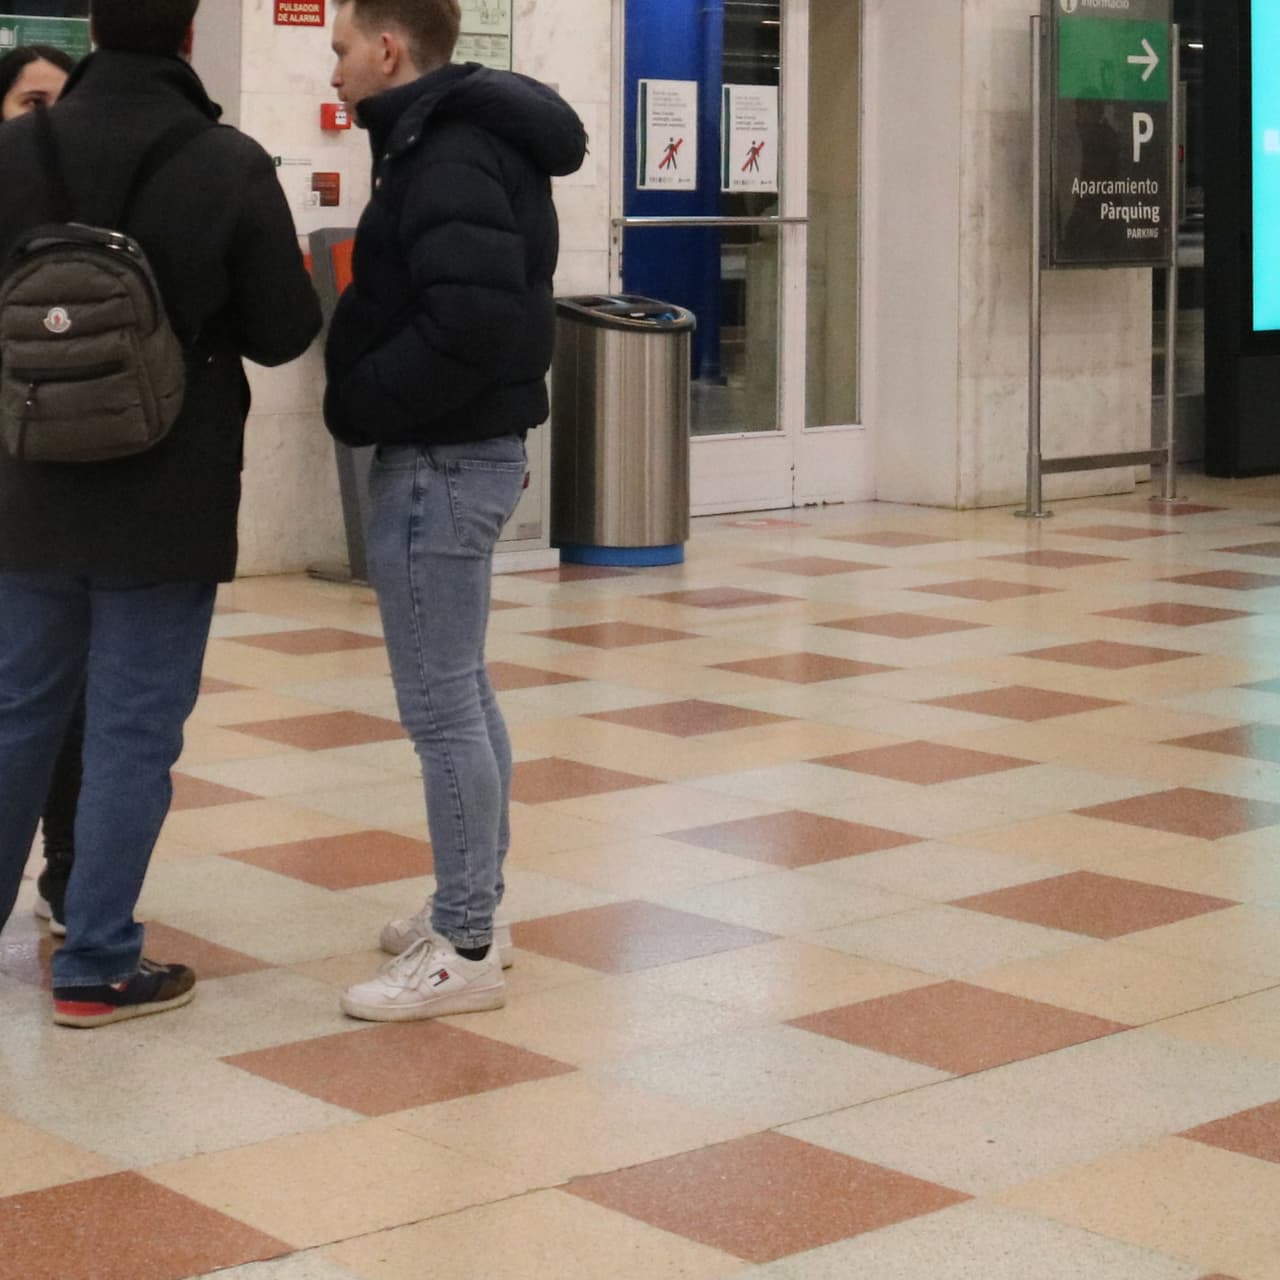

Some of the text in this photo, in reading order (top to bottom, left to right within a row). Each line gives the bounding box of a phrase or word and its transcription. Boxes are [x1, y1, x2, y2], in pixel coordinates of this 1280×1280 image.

[279, 3, 320, 12] PULSADOR
[277, 13, 321, 23] DE ALARMA
[1132, 111, 1154, 163] P
[1071, 176, 1159, 199] Aparcamiento
[1100, 200, 1160, 223] Pàrquing
[1126, 227, 1159, 239] PARKING
